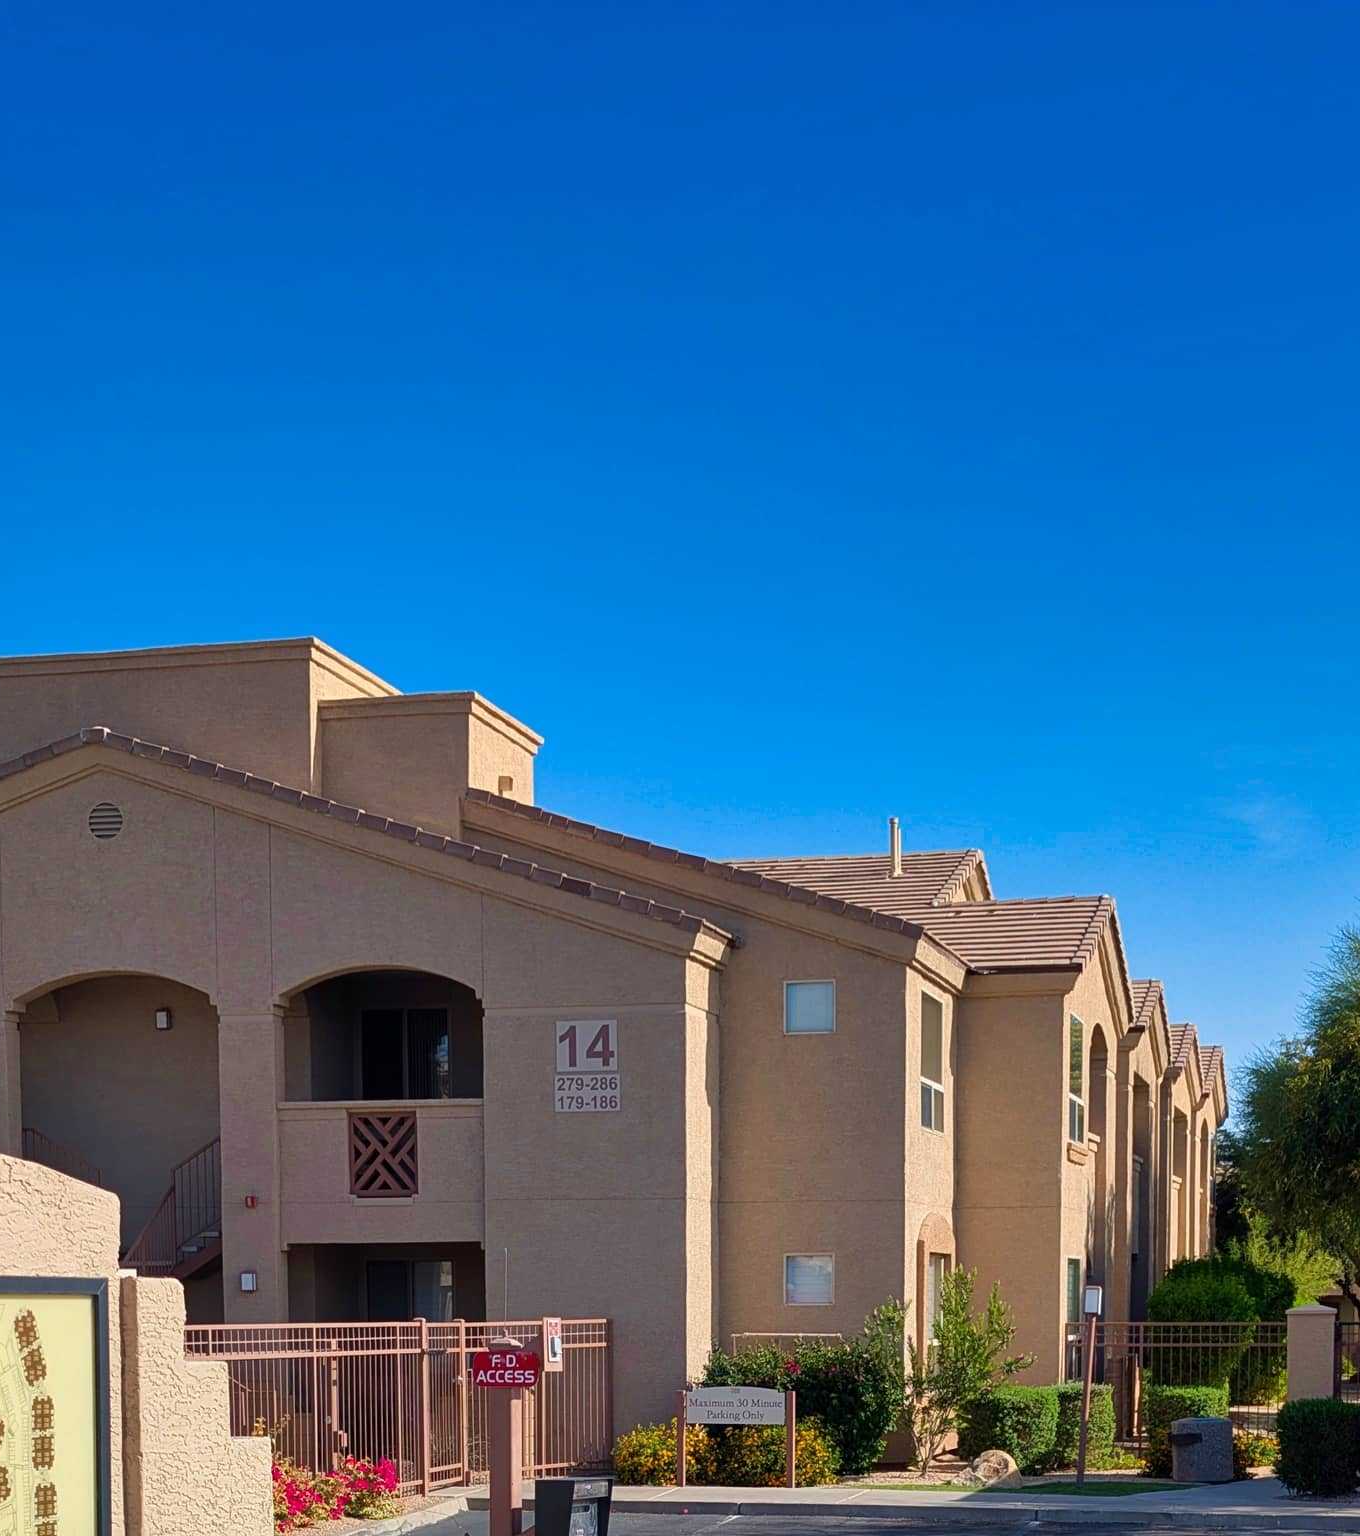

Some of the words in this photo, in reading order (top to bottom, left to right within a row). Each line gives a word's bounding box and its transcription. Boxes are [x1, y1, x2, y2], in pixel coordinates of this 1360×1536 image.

[558, 1024, 615, 1068] 14
[556, 1077, 618, 1091] 279-286
[557, 1095, 618, 1110] 179-186
[476, 1370, 535, 1384] ACCESS
[689, 1398, 734, 1408] Maximum
[736, 1398, 749, 1408] 30
[751, 1398, 783, 1408] Minute
[706, 1410, 740, 1421] Parking
[742, 1410, 765, 1421] Only
